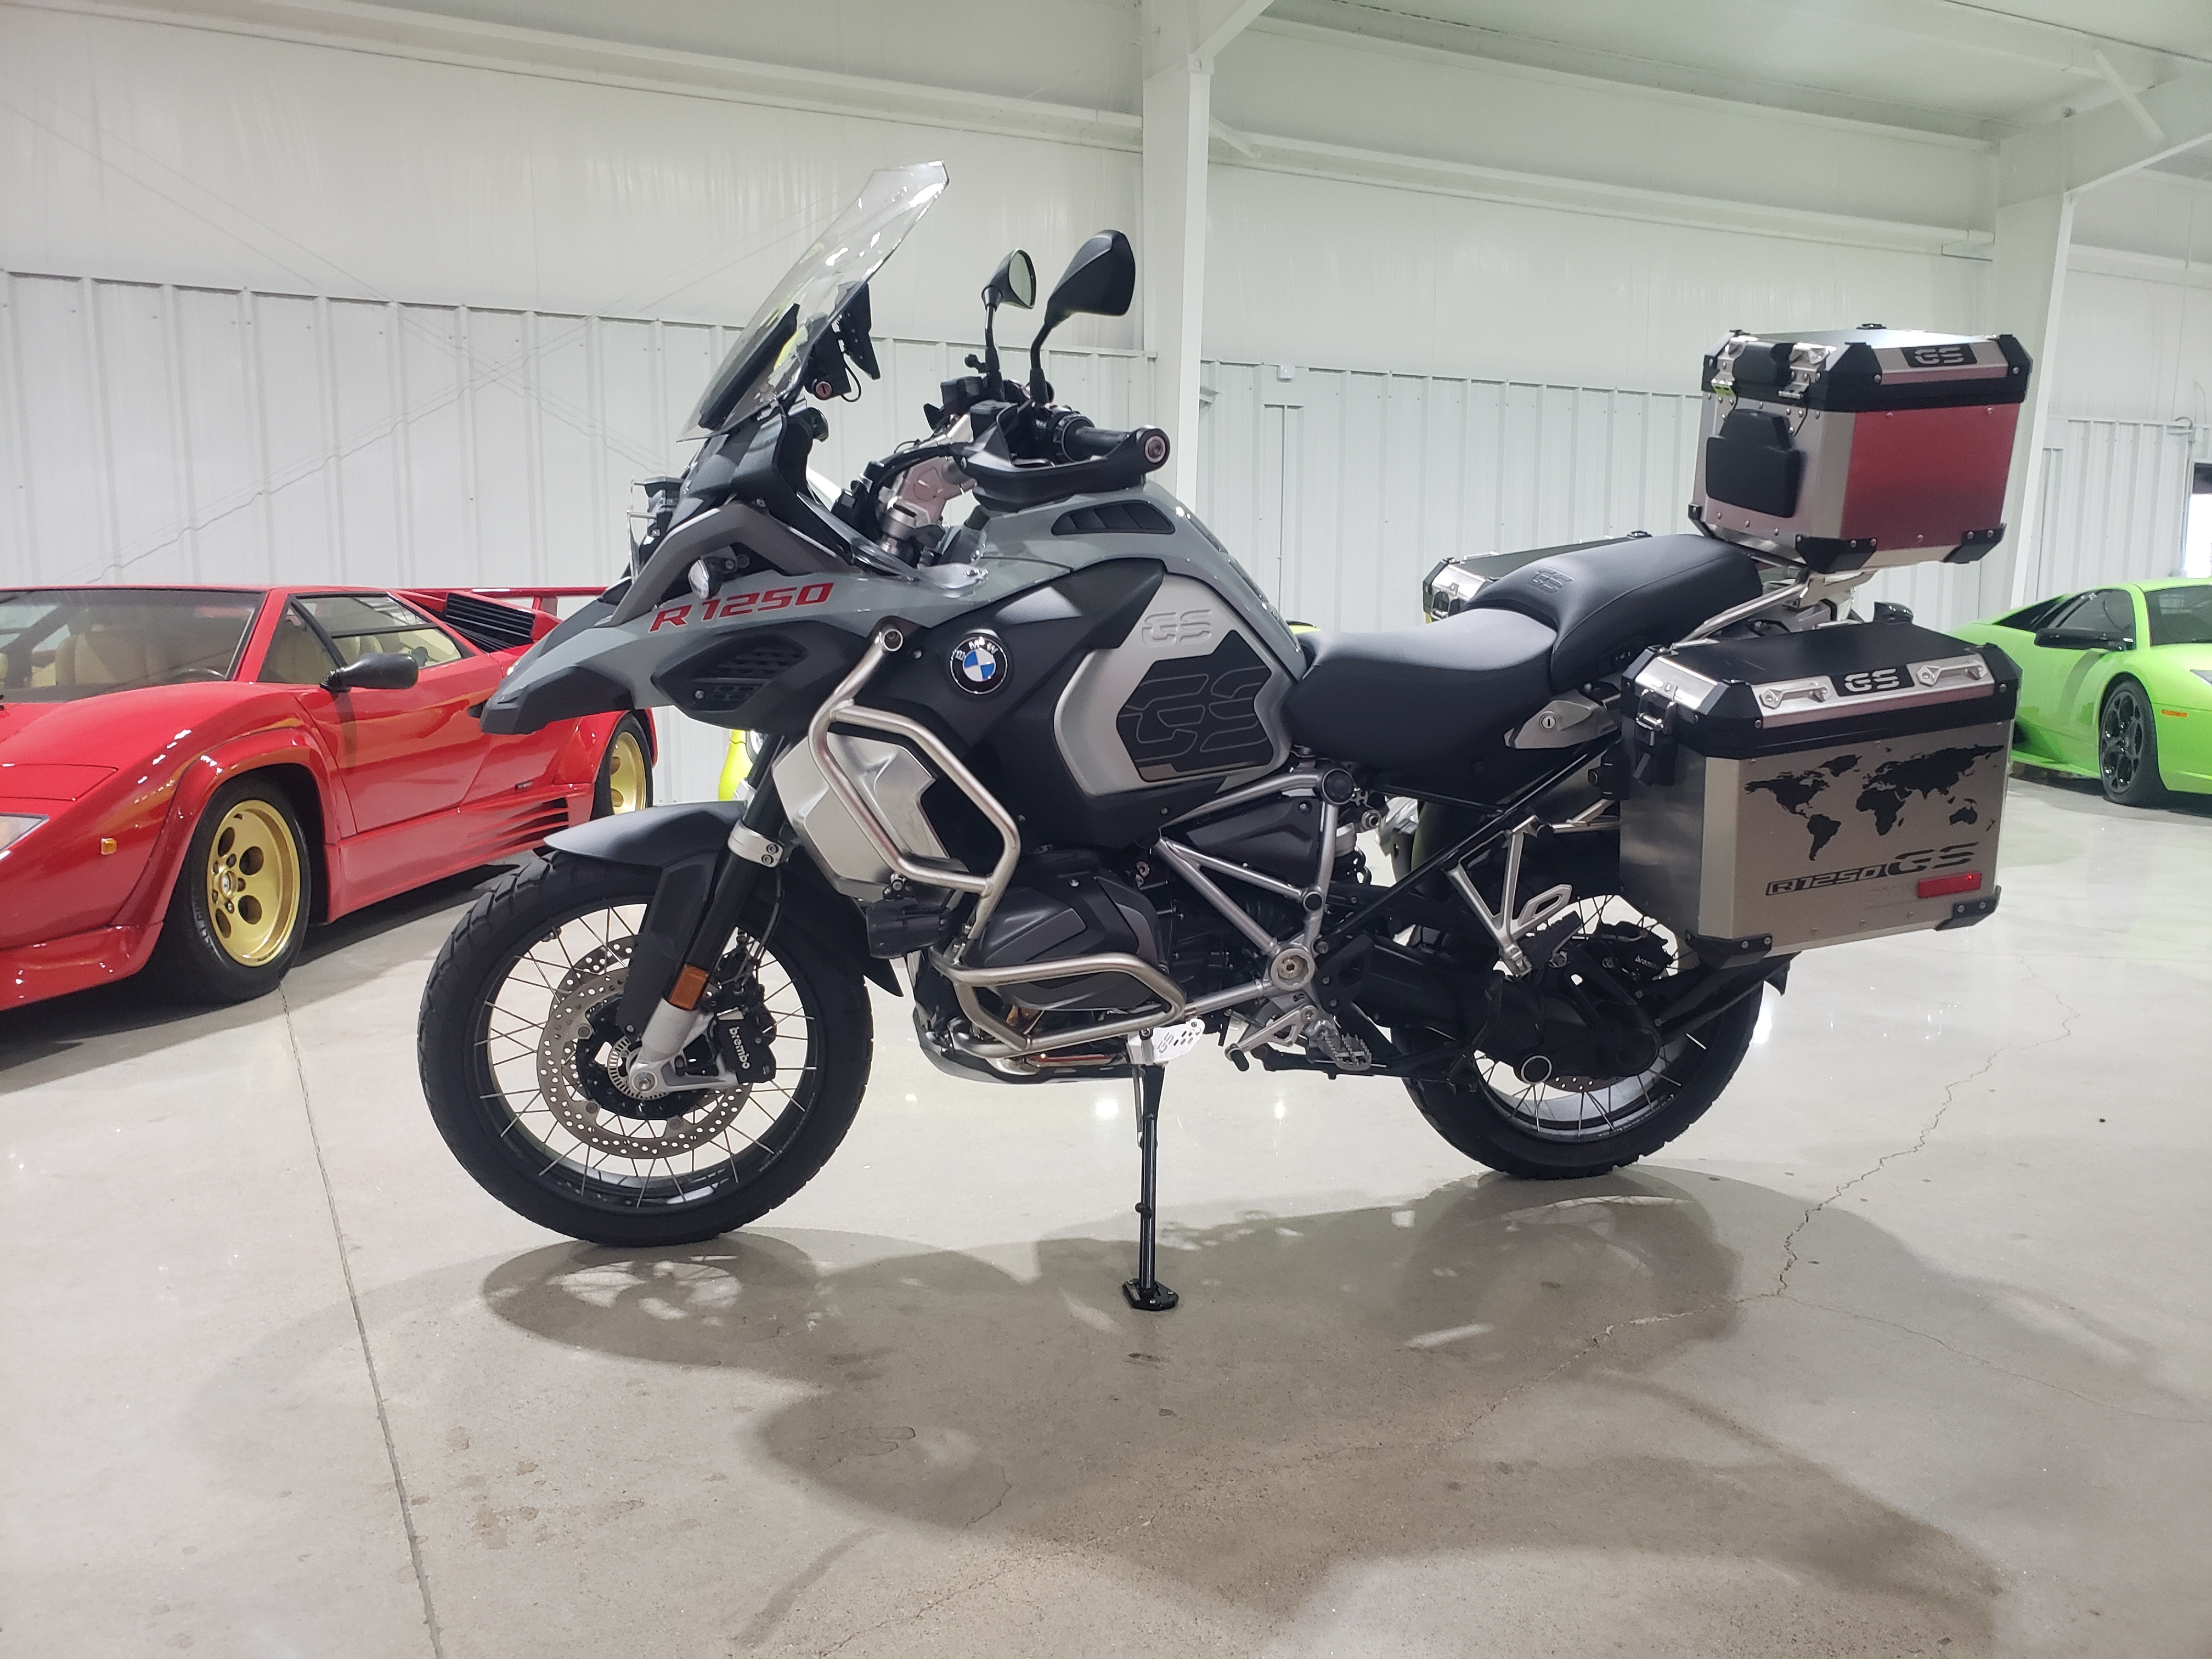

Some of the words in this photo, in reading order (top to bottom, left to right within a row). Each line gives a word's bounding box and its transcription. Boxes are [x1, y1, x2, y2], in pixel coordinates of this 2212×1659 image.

[1915, 347, 1964, 364] GS
[1141, 609, 1213, 647] GS
[955, 639, 998, 662] BMW
[1844, 668, 1900, 692] GS
[729, 1026, 751, 1070] brembo
[1157, 1031, 1175, 1053] GS
